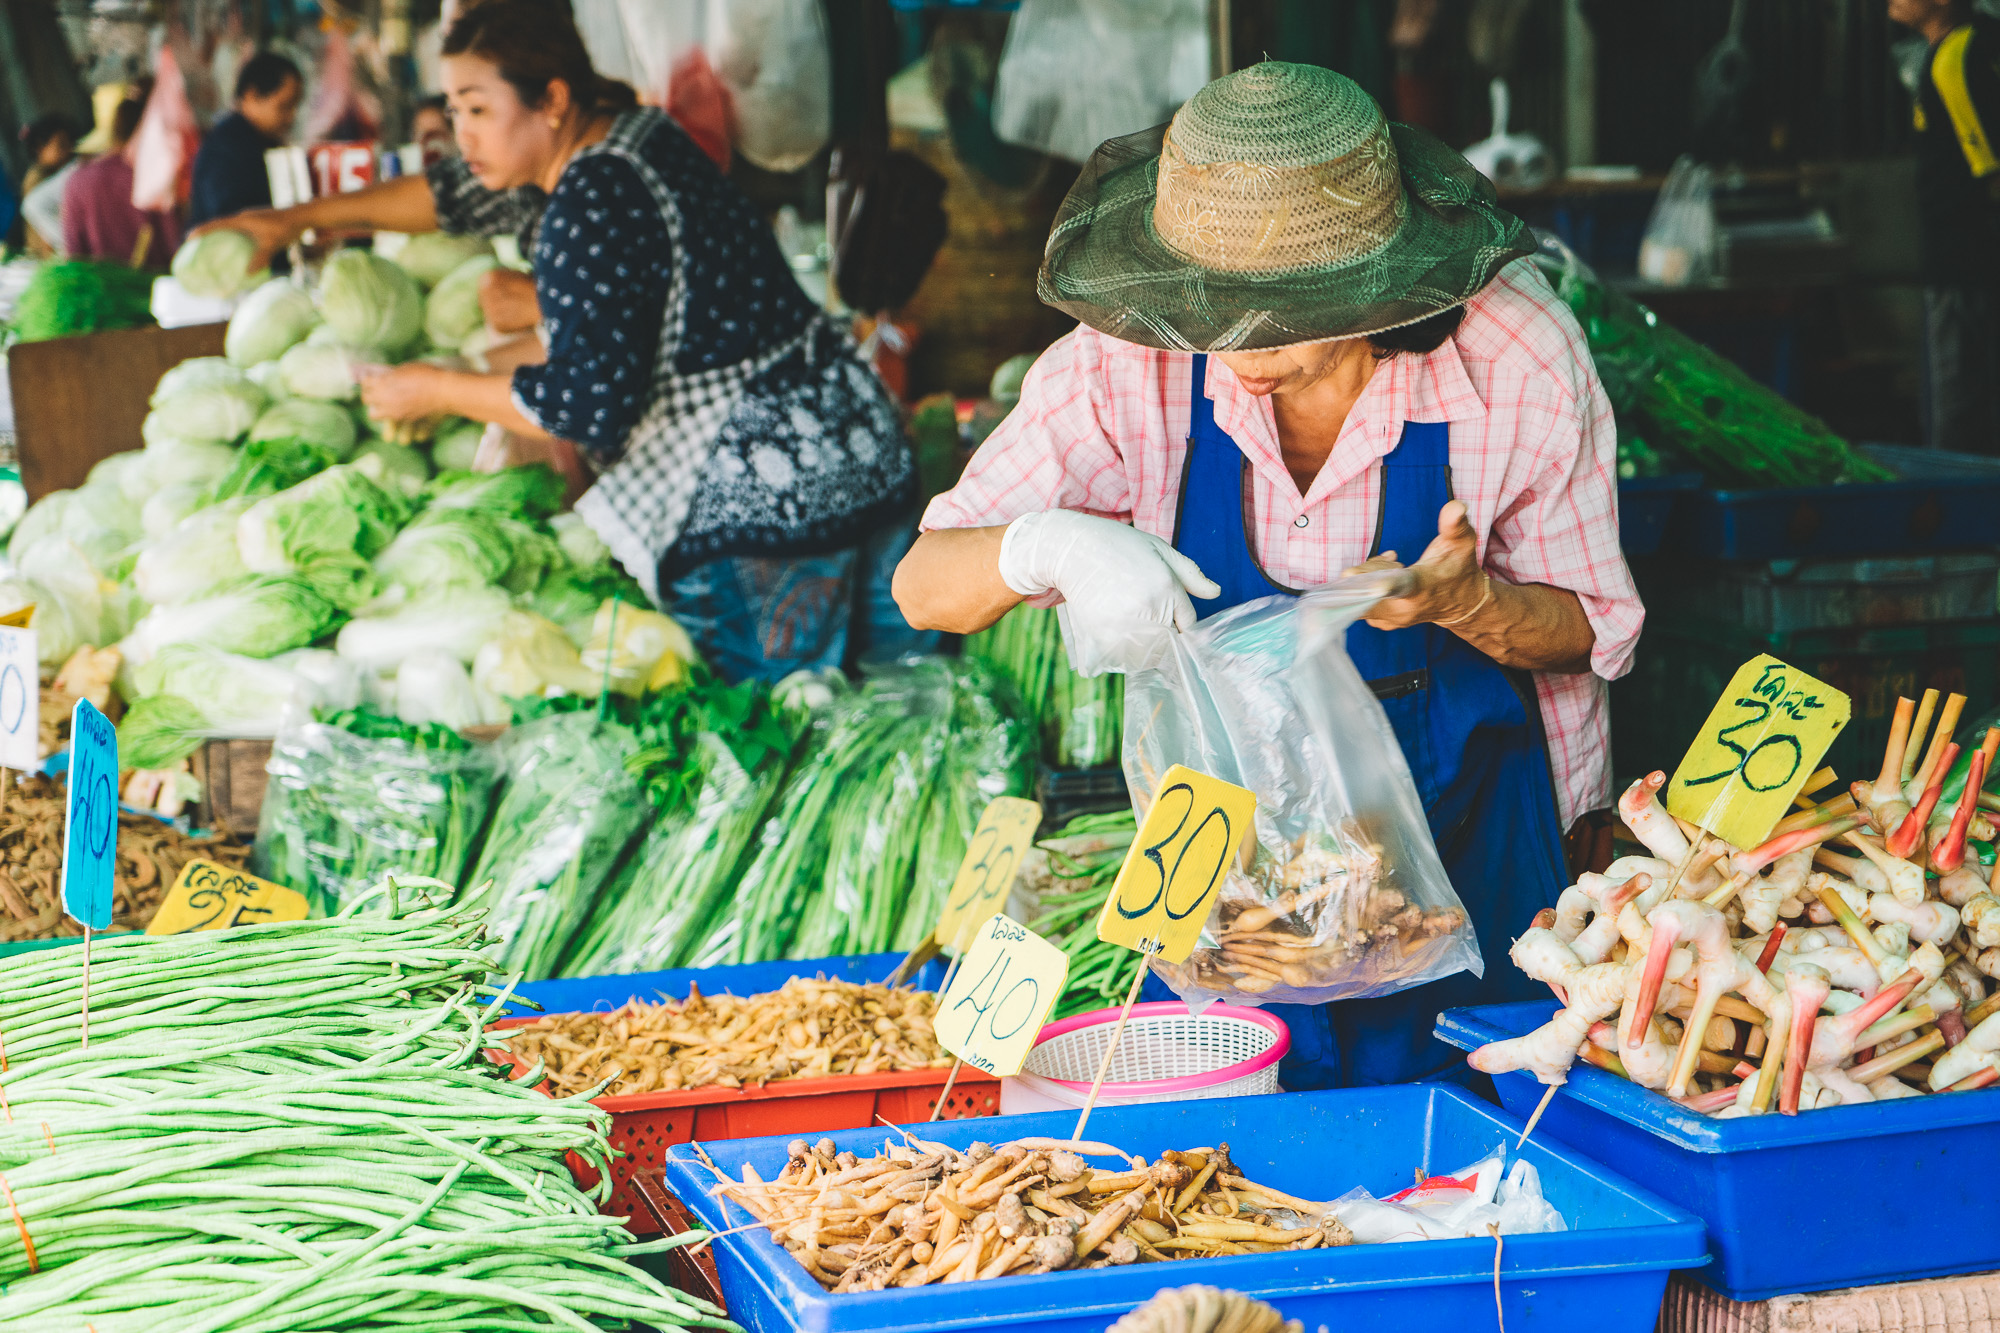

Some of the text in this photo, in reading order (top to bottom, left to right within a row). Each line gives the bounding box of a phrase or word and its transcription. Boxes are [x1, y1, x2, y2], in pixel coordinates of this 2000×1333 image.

[70, 748, 112, 880] 40
[1116, 782, 1231, 921] 30
[953, 947, 1039, 1047] 40
